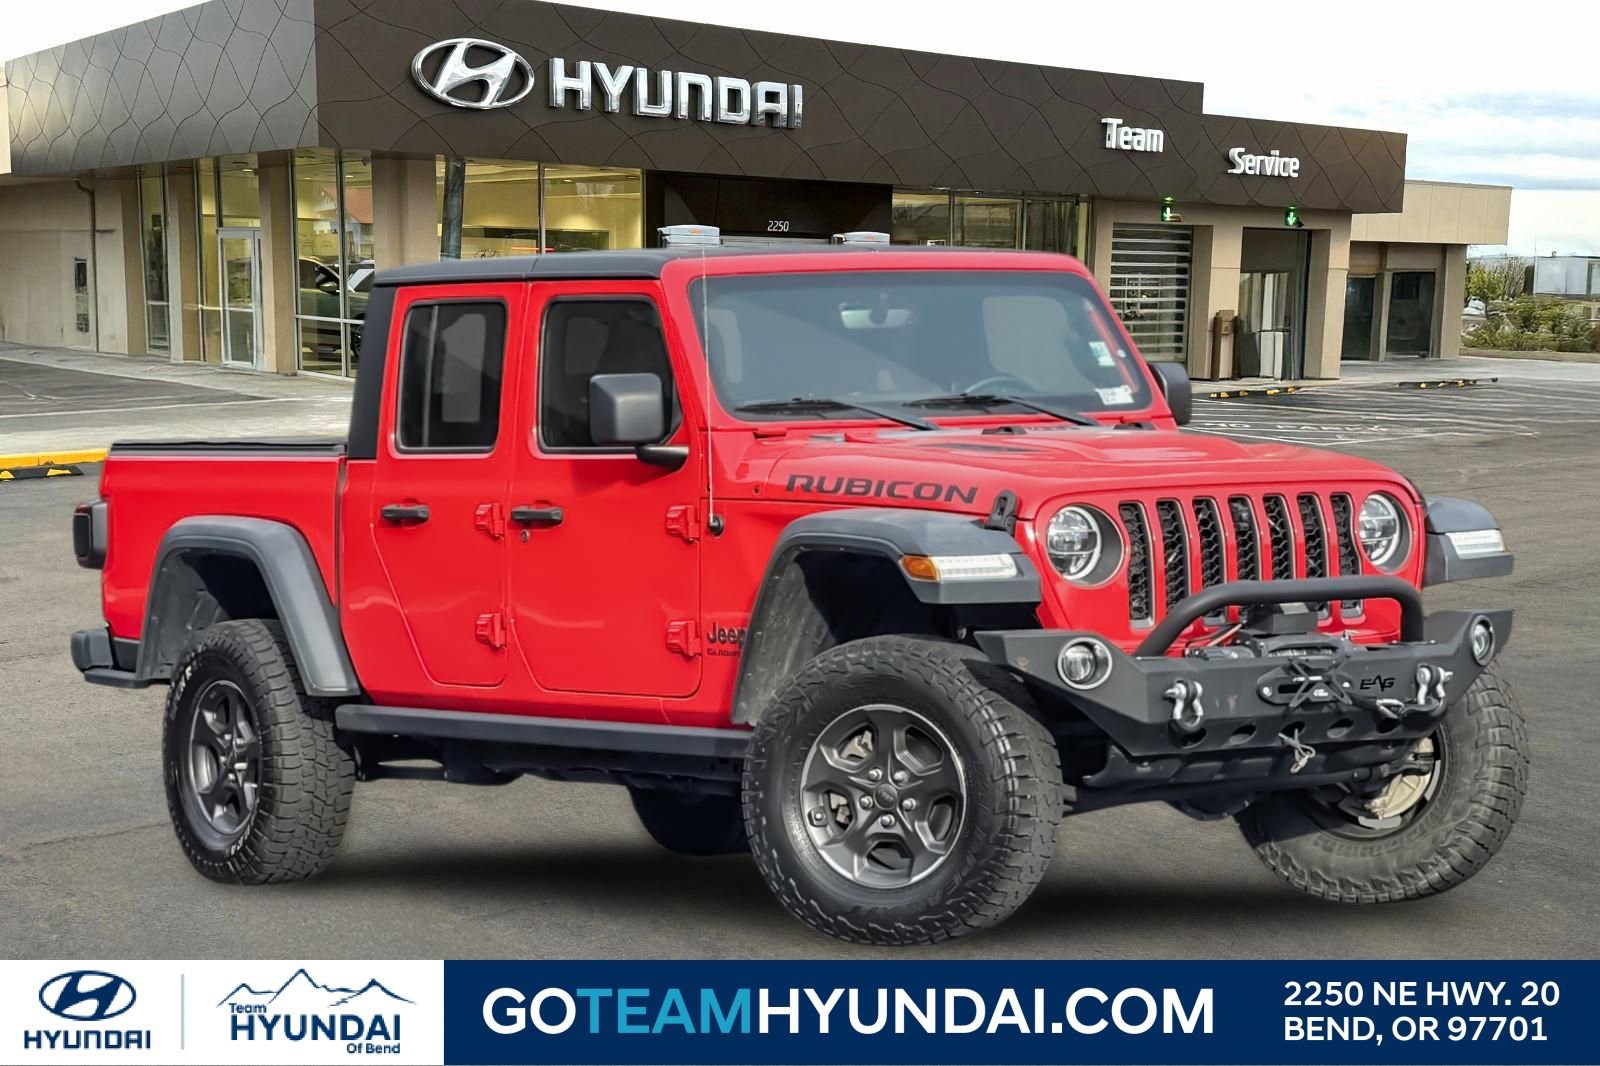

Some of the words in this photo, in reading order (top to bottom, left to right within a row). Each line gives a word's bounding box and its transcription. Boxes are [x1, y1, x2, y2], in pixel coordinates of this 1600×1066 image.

[549, 57, 803, 128] HYUNDAI
[1102, 117, 1164, 152] Team
[1228, 147, 1300, 178] Service
[767, 220, 790, 232] 2250
[786, 474, 979, 504] RUBICON
